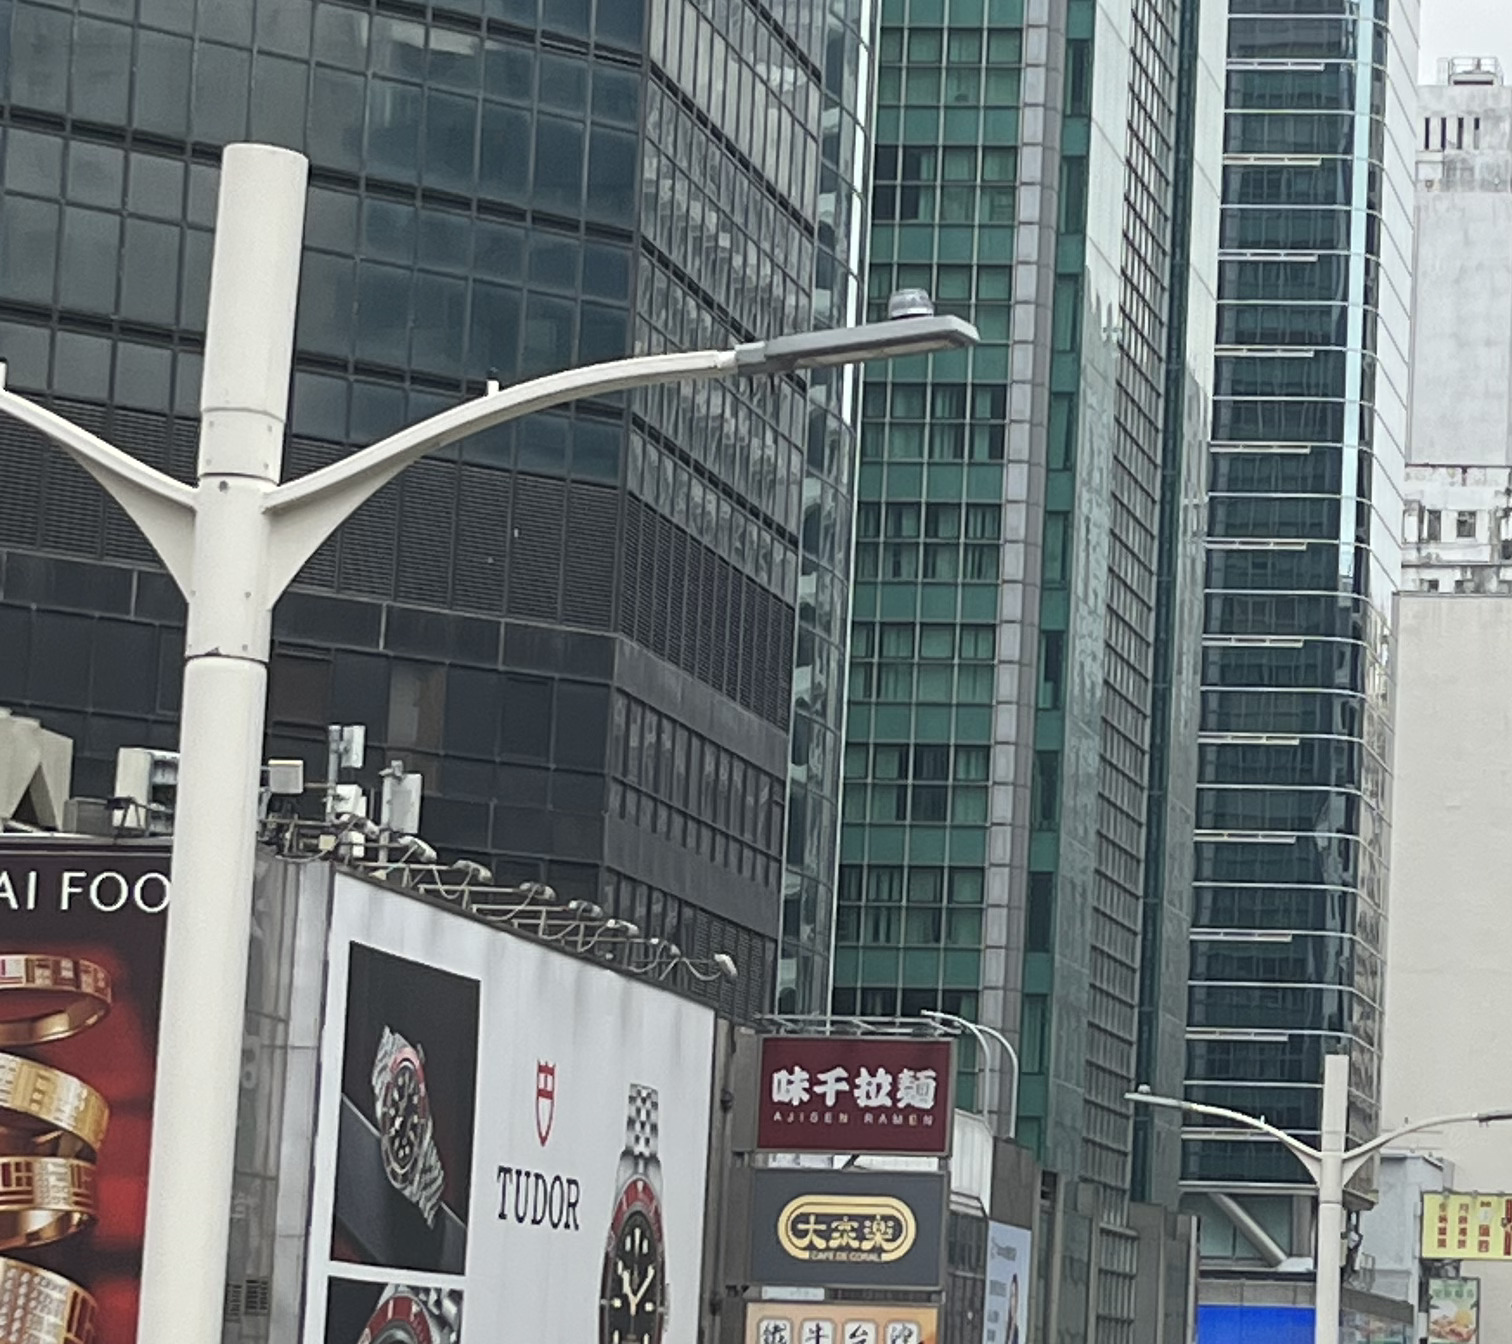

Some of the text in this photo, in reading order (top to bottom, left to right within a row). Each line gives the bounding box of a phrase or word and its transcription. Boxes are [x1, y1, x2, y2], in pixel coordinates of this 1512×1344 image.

[771, 1066, 937, 1109] 味千拉麵
[773, 1111, 933, 1126] AJISEN RAMEN
[497, 1165, 580, 1231] TUDOR
